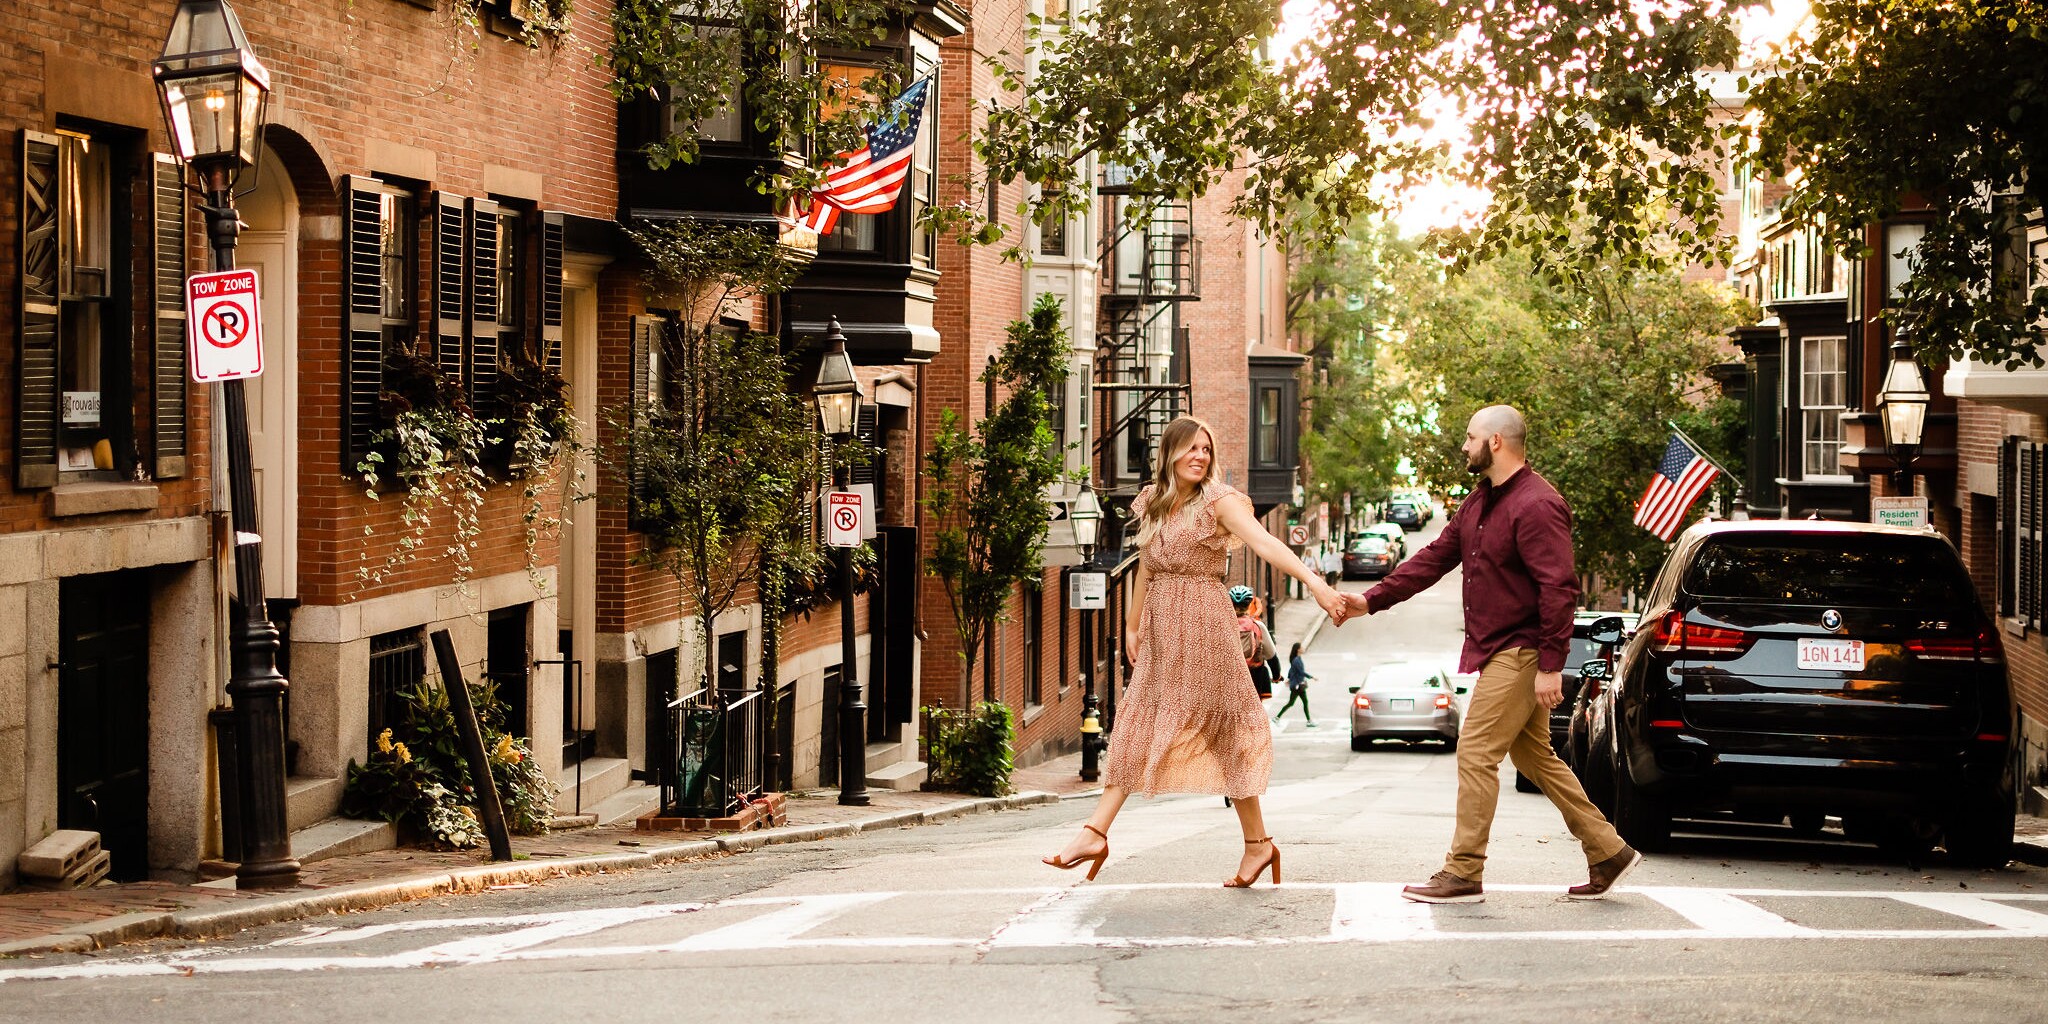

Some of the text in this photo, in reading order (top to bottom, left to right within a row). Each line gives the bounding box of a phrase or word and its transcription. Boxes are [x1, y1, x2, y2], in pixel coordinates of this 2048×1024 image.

[193, 277, 252, 294] TOW ZONE
[72, 396, 100, 410] rouvalis
[1879, 510, 1919, 518] Resident
[1885, 519, 1913, 527] Permit
[1802, 647, 1860, 663] 1GN 141
